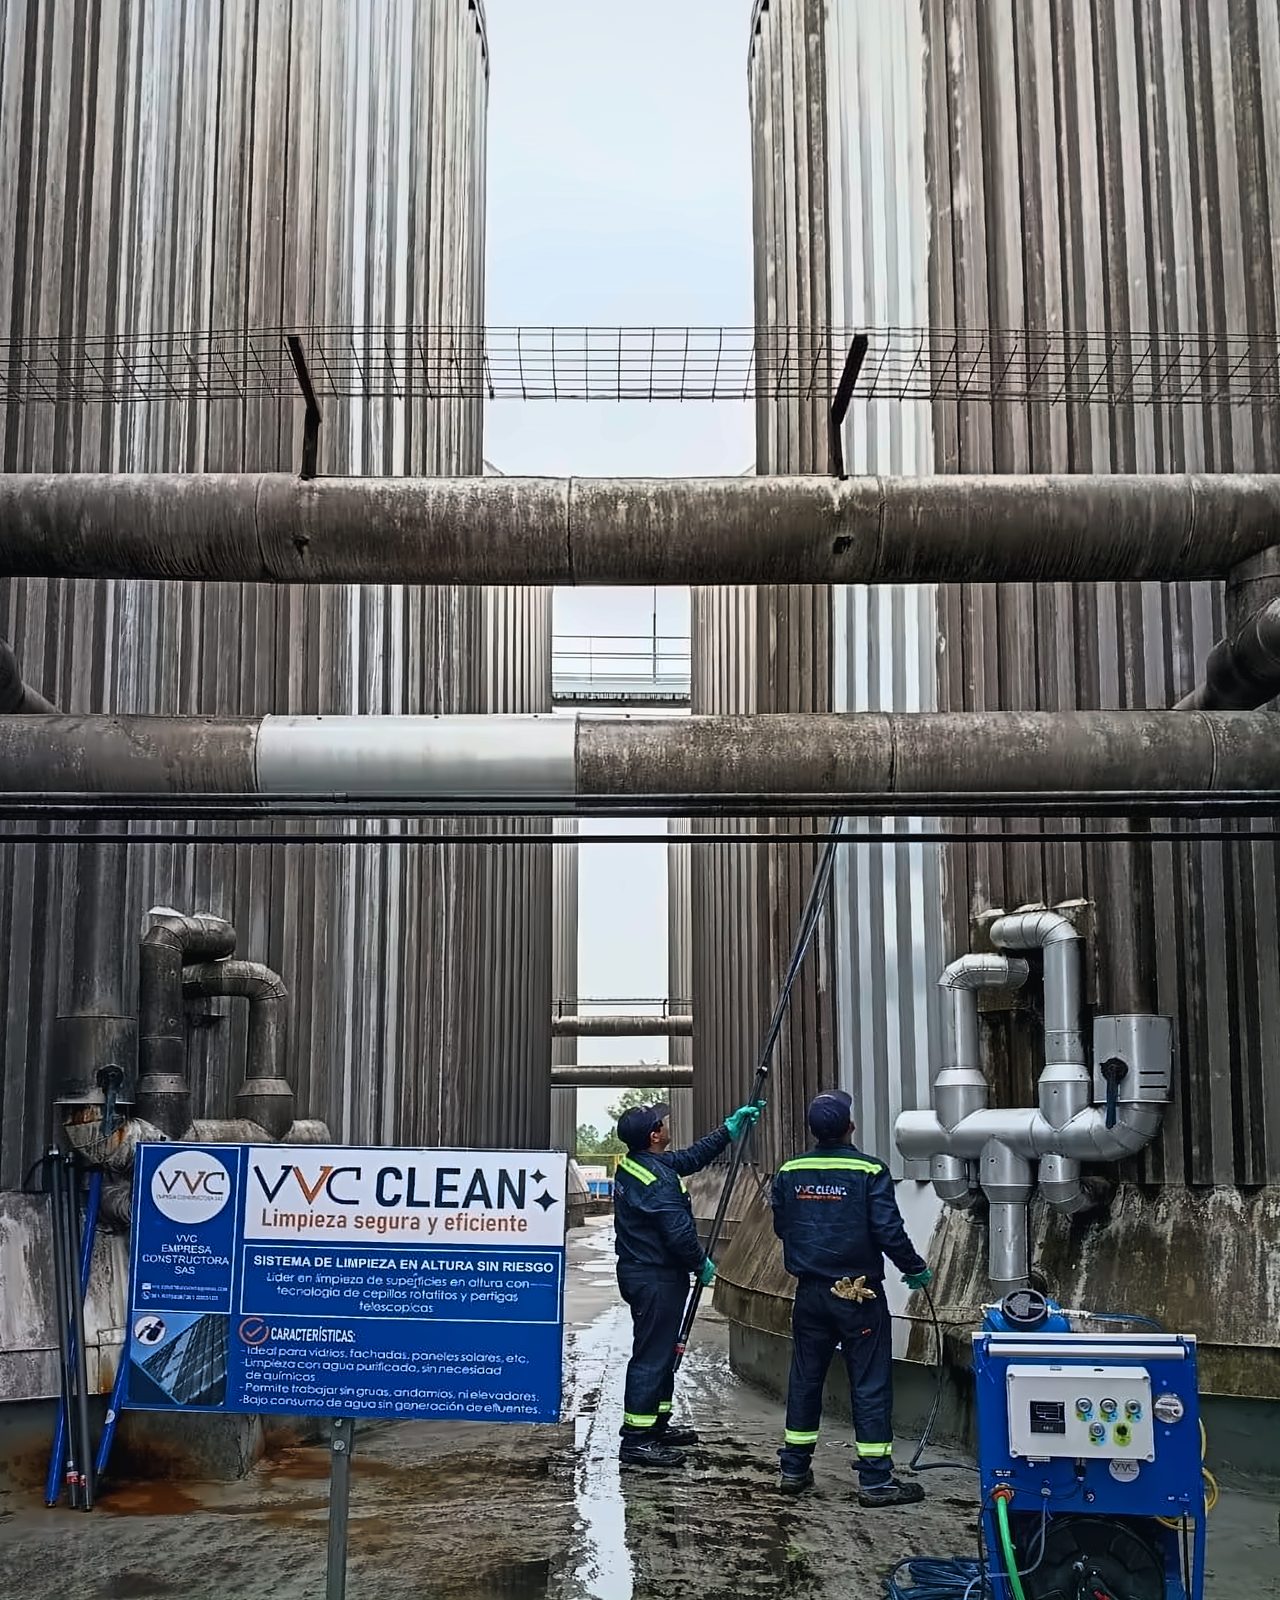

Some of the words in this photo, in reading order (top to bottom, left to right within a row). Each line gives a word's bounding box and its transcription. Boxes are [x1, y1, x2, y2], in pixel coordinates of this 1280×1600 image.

[158, 1170, 225, 1195] VVC
[253, 1165, 361, 1205] VVC
[376, 1166, 526, 1209] CLEAN
[262, 1208, 347, 1232] Limpieza
[354, 1214, 420, 1234] segura
[428, 1216, 438, 1235] y
[444, 1213, 527, 1232] eficiente
[176, 1234, 198, 1243] VVC
[161, 1244, 212, 1254] EMPRESA
[142, 1254, 229, 1265] CONSTRUCTORA
[253, 1255, 311, 1267] SISTEMA
[314, 1257, 332, 1268] DE
[336, 1257, 397, 1269] LIMPIEZA
[400, 1259, 418, 1270] EN
[420, 1260, 474, 1271] ALTURA
[477, 1261, 499, 1272] SIN
[502, 1262, 554, 1273] RIESGO
[174, 1266, 196, 1275] SAS
[366, 1275, 383, 1285] de
[450, 1278, 466, 1287] en
[468, 1277, 503, 1288] altura
[343, 1287, 360, 1298] de
[363, 1288, 407, 1300] cepillos
[460, 1293, 467, 1302] y
[271, 1326, 356, 1343] CARACTERÍSTICAS:
[278, 1348, 307, 1358] para
[411, 1351, 459, 1362] paneles
[245, 1370, 261, 1380] de
[297, 1360, 321, 1369] con
[322, 1361, 355, 1372] agua
[422, 1364, 437, 1374] sin
[438, 1364, 502, 1375] necesidad
[291, 1384, 337, 1397] trabajar
[339, 1386, 355, 1395] sin
[458, 1389, 469, 1399] ni
[270, 1397, 324, 1407] consumo
[326, 1397, 342, 1408] de
[344, 1400, 376, 1410] agua
[377, 1399, 393, 1409] sin
[395, 1401, 464, 1412] generación
[466, 1402, 483, 1412] de
